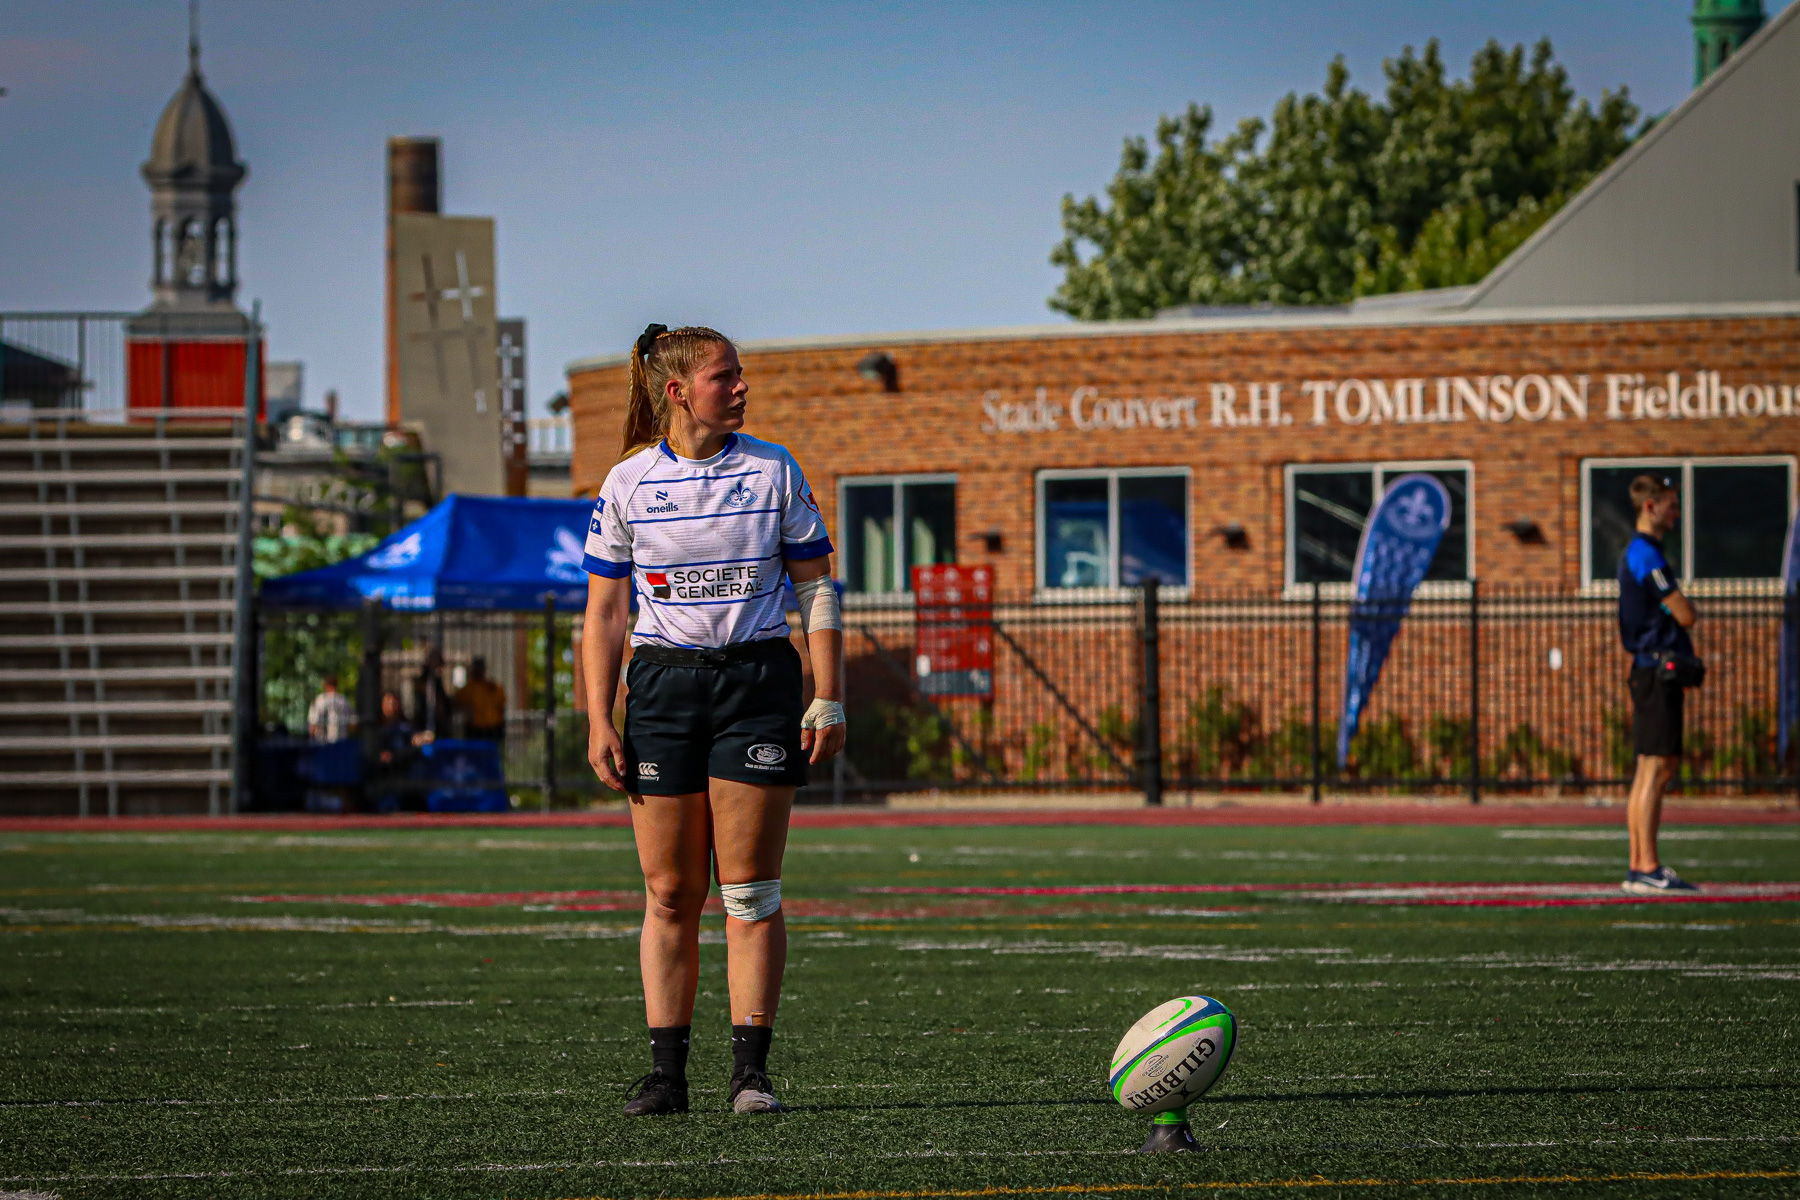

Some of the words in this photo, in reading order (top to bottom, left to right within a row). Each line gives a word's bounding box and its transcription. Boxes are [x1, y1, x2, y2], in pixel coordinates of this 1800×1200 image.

[982, 387, 1060, 435] Stade
[1070, 384, 1198, 431] Couvert
[1209, 381, 1295, 428] R.H.
[1302, 373, 1590, 428] TOMLINSON
[674, 565, 759, 584] SOCIETE
[1126, 1038, 1216, 1110] GILBERT
